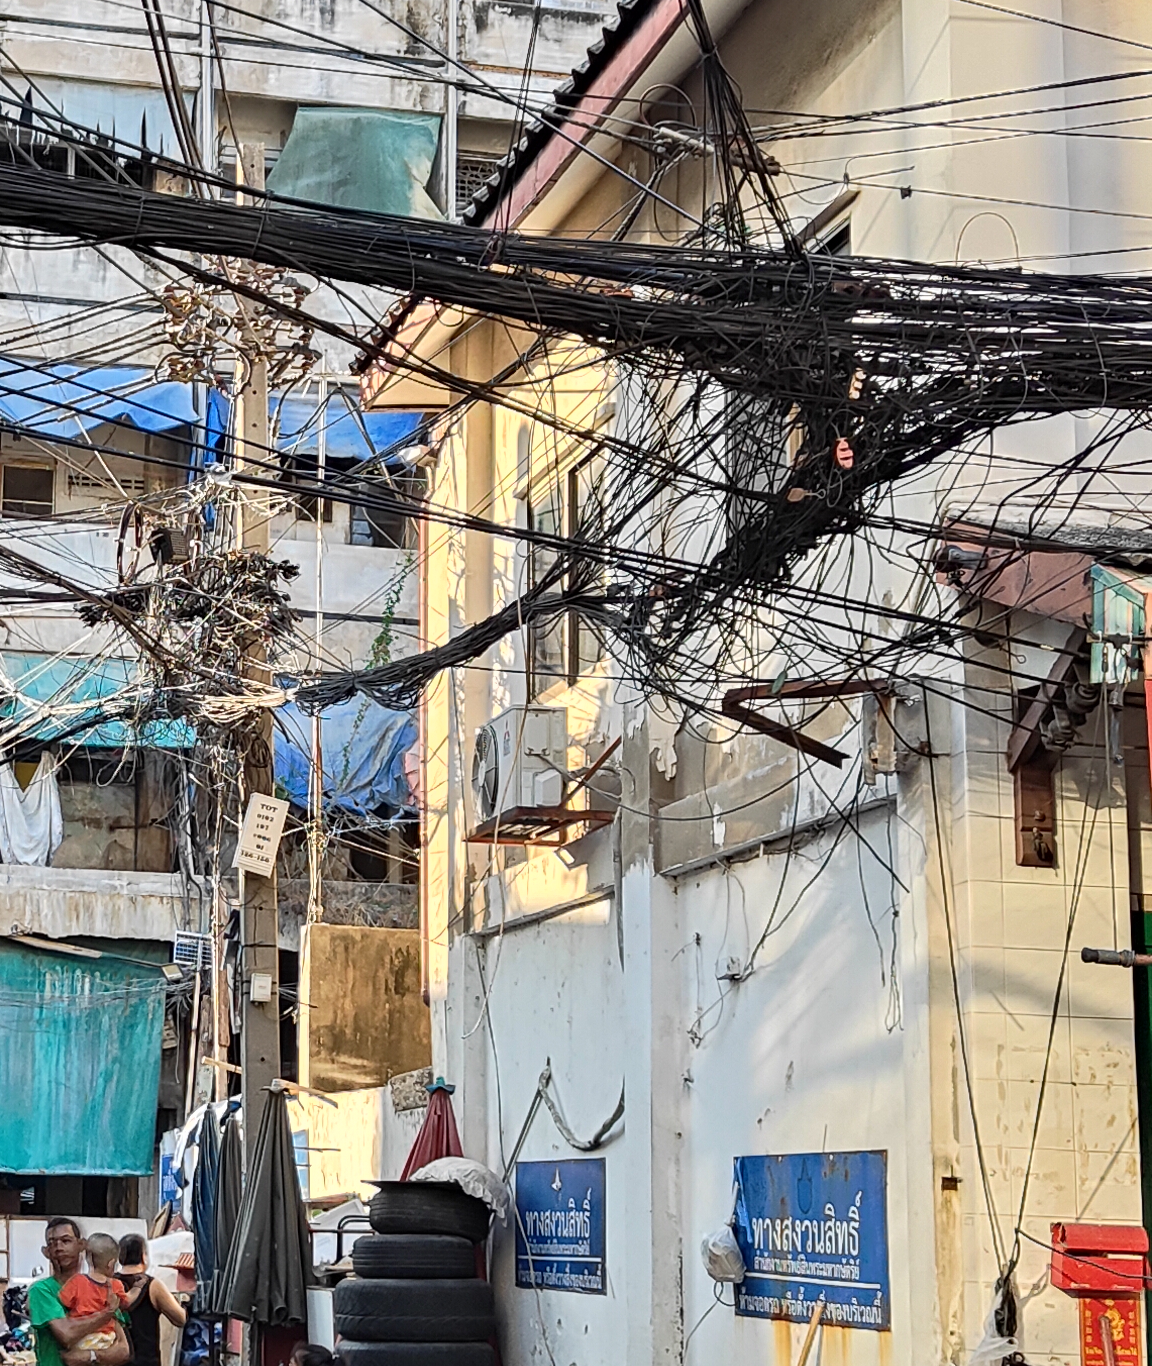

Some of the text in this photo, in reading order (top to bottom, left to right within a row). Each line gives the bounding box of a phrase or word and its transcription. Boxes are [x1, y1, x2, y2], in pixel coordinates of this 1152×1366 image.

[260, 803, 278, 813] TOT
[524, 1187, 592, 1238] ทางสงวนสิทธิ์
[752, 1190, 862, 1256] ทางสงวนสิทธิ์
